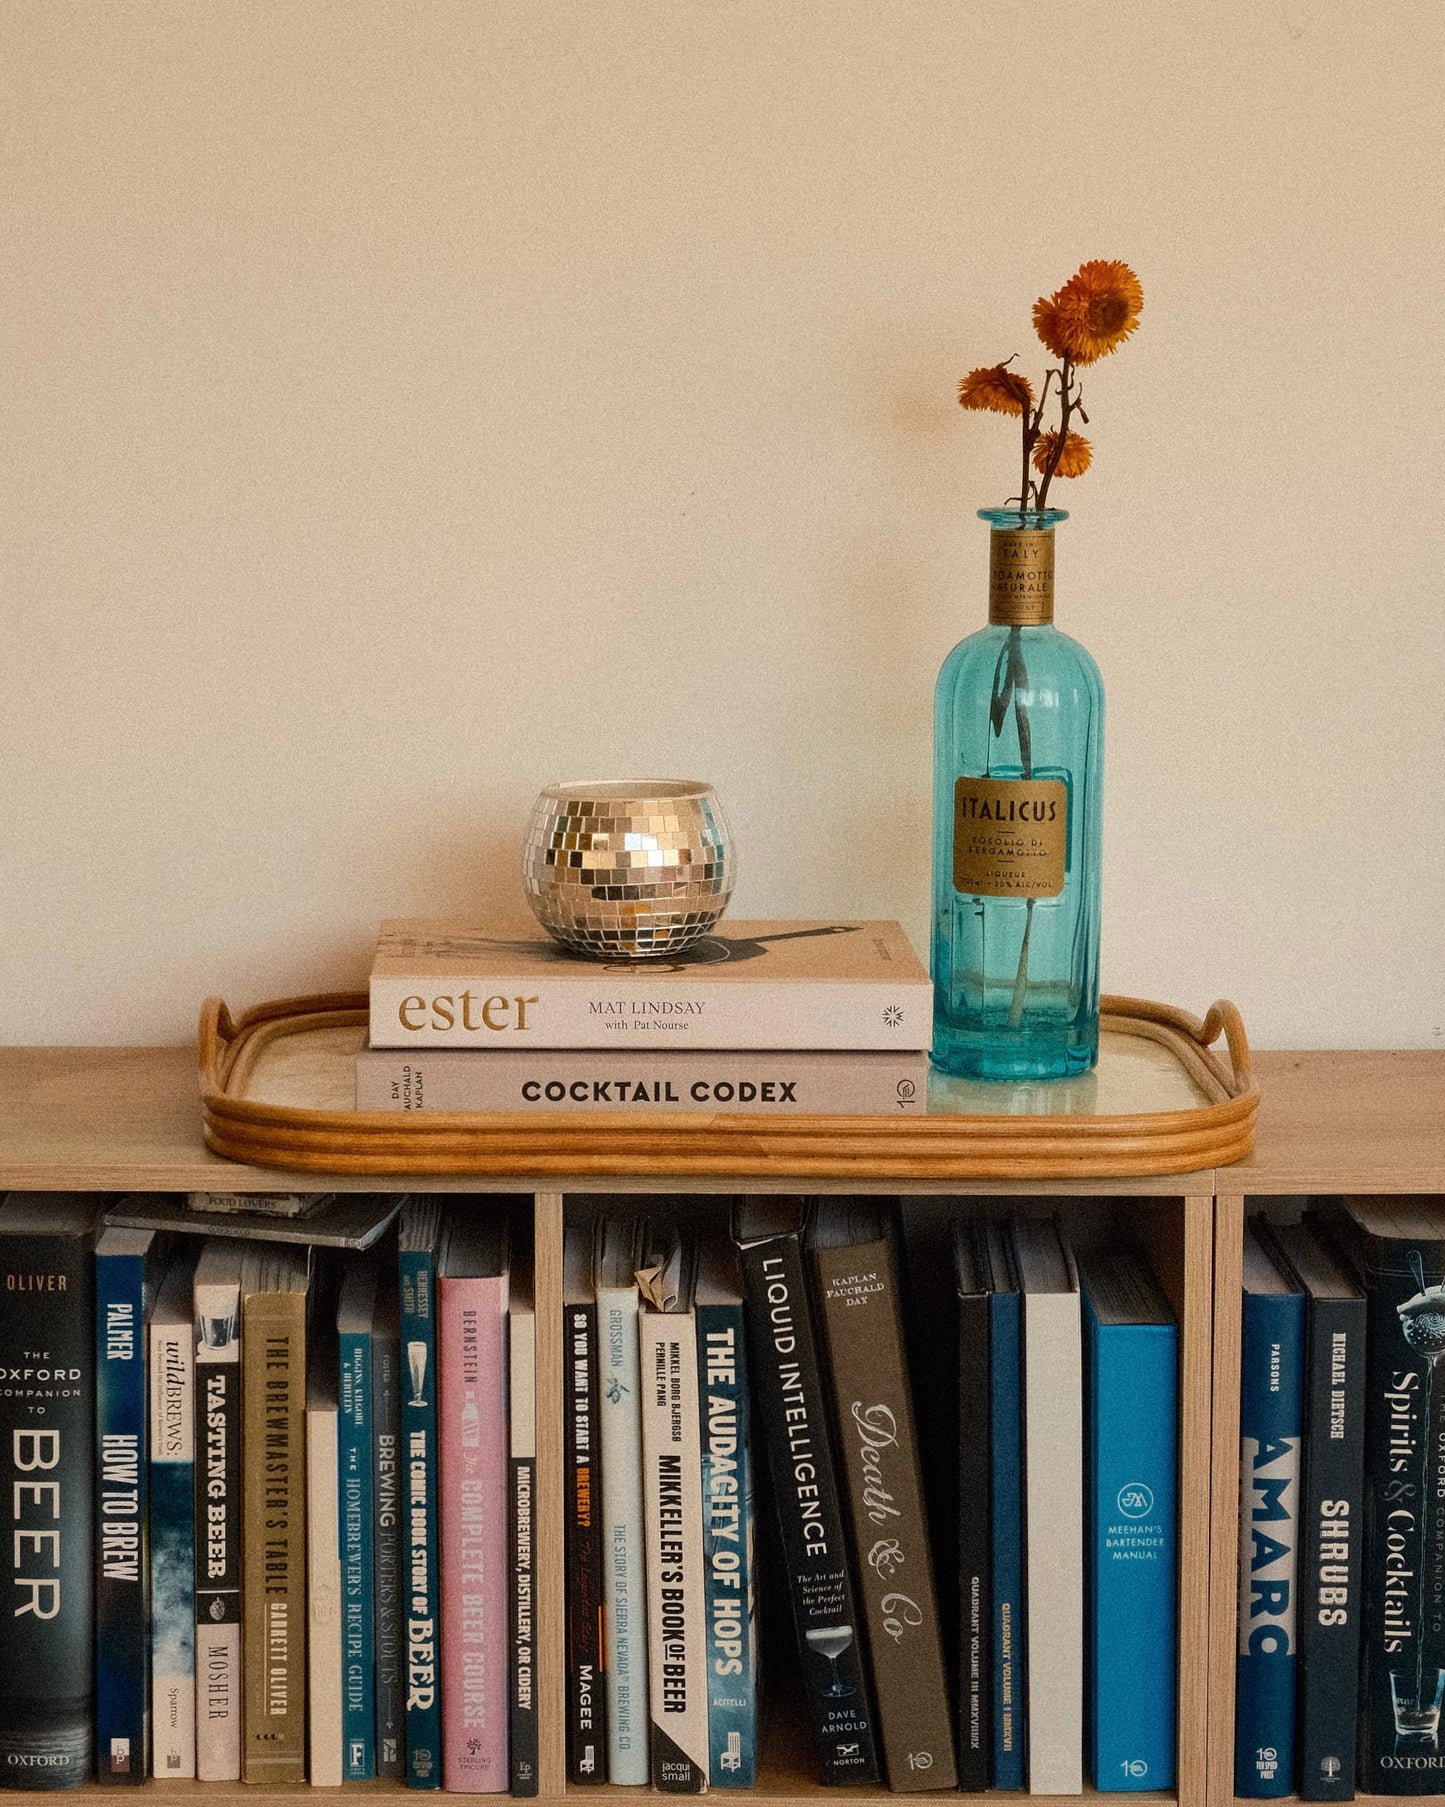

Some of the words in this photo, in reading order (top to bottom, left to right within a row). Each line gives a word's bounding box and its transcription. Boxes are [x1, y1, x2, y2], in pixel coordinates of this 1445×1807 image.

[997, 549, 1038, 558] ITALY
[963, 797, 1056, 822] ITALICUS
[972, 836, 1024, 846] ROSOLIO
[398, 988, 540, 1031] ester
[589, 1001, 627, 1014] MAT
[631, 1001, 706, 1014] LINDSAY
[605, 1020, 628, 1030] with
[634, 1020, 650, 1030] Pat
[653, 1020, 689, 1030] Nourse
[521, 1080, 679, 1102] COCKTAIL
[690, 1081, 797, 1103] CODEX
[209, 1198, 236, 1207] FOOD
[239, 1200, 276, 1209] LOVERS
[7, 1274, 67, 1291] OLIVER
[418, 1271, 428, 1318] HENNESSEY
[826, 1281, 886, 1299] FAUCHALD
[831, 1272, 878, 1286] KAPLAN
[404, 1288, 414, 1313] SMITH
[845, 1297, 868, 1306] DAY
[106, 1303, 133, 1360] PALMER
[573, 1314, 587, 1329] SO
[609, 1309, 623, 1367] GROSSMAN
[23, 1351, 50, 1360] THE
[266, 1337, 289, 1369] THE
[463, 1310, 478, 1383] BERNSTEIN
[574, 1333, 587, 1355] YOU
[656, 1342, 666, 1381] PERNILLE
[670, 1342, 680, 1374] MIKKEL
[706, 1328, 735, 1385] THE
[1331, 1333, 1346, 1385] MICHAEL
[382, 1355, 391, 1383] FOSTER
[575, 1360, 588, 1392] WANT
[1270, 1344, 1280, 1391] PARSONS
[575, 1398, 588, 1412] TO
[657, 1384, 666, 1406] PANG
[671, 1378, 680, 1400] BORG
[762, 1258, 796, 1353] LIQUID
[780, 1363, 827, 1557] INTELLIGENCE
[576, 1416, 589, 1450] START
[1330, 1390, 1345, 1439] DIETSCH
[1383, 1371, 1420, 1472] Spirits
[207, 1375, 226, 1499] TASTING
[266, 1380, 288, 1529] BREWMASTER'S
[411, 1430, 426, 1457] THE
[102, 1434, 138, 1484] HOW
[349, 1448, 358, 1471] THE
[463, 1450, 478, 1474] The
[577, 1455, 589, 1463] A
[708, 1396, 739, 1541] AUDACITY
[850, 1400, 900, 1526] Death
[379, 1435, 395, 1526] BREWING
[411, 1462, 426, 1504] COMIC
[577, 1468, 590, 1527] BREWERY?
[1379, 1479, 1417, 1503] &
[102, 1489, 138, 1514] TO
[514, 1466, 531, 1573] MICROBREWERY,
[659, 1455, 684, 1583] MIKKELLER'S
[12, 1429, 60, 1620] BEER
[207, 1505, 226, 1579] BEER
[346, 1478, 363, 1595] HOMEBREWER'S
[411, 1509, 427, 1546] BOOK
[461, 1479, 484, 1584] COMPLETE
[614, 1524, 626, 1542] THE
[1105, 1537, 1165, 1547] BARTENDER
[1108, 1525, 1162, 1534] MEEHAN'S
[102, 1522, 138, 1582] BREW
[614, 1546, 627, 1578] STORY
[868, 1538, 905, 1581] &
[1112, 1551, 1158, 1560] MANUAL
[1248, 1437, 1292, 1655] AMARO
[1318, 1500, 1350, 1626] SHRUBS
[1434, 1506, 1444, 1603] COMPANION
[265, 1540, 288, 1594] TABLE
[381, 1532, 398, 1603] PORTERS
[411, 1550, 427, 1593] STORY
[712, 1551, 740, 1589] OF
[797, 1575, 812, 1583] The
[828, 1570, 844, 1579] and
[1383, 1509, 1415, 1653] Cocktails
[412, 1597, 428, 1615] OF
[616, 1582, 628, 1594] OF
[802, 1585, 831, 1594] Science
[834, 1582, 843, 1592] of
[802, 1596, 815, 1605] the
[817, 1594, 845, 1604] Perfect
[971, 1576, 979, 1633] QUADRANT
[381, 1607, 397, 1618] &
[462, 1594, 485, 1643] BEER
[516, 1575, 531, 1645] DISTILLERY,
[615, 1597, 629, 1634] SIERRA
[662, 1588, 685, 1641] BOOK
[809, 1607, 842, 1616] Cocktail
[880, 1592, 923, 1644] Co
[1432, 1612, 1441, 1632] TO
[270, 1603, 287, 1661] GARRETT
[347, 1604, 362, 1657] RECIPE
[713, 1598, 742, 1676] HOPS
[1002, 1603, 1010, 1658] QUADRANT
[381, 1624, 398, 1684] STOUTS
[406, 1618, 434, 1711] BEER
[518, 1647, 531, 1664] OR
[668, 1644, 685, 1661] OF
[971, 1636, 979, 1678] VOLUME
[208, 1646, 229, 1720] MOSHER
[269, 1668, 287, 1715] OLIVER
[348, 1665, 363, 1712] GUIDE
[463, 1652, 485, 1728] COURSE
[517, 1666, 531, 1710] CIDERY
[578, 1665, 592, 1729] MAGEE
[663, 1664, 686, 1713] BEER
[971, 1681, 979, 1691] III
[1003, 1662, 1011, 1704] VOLUME
[168, 1688, 180, 1728] Sparrow
[617, 1685, 630, 1732] BREWING
[821, 1721, 867, 1733] ARNOLD
[828, 1710, 857, 1720] DAVE
[7, 1755, 70, 1766] OXFORD
[619, 1736, 631, 1753] CO.
[833, 1758, 865, 1766] NORTON
[662, 1762, 690, 1771] jacqui
[662, 1773, 691, 1781] small
